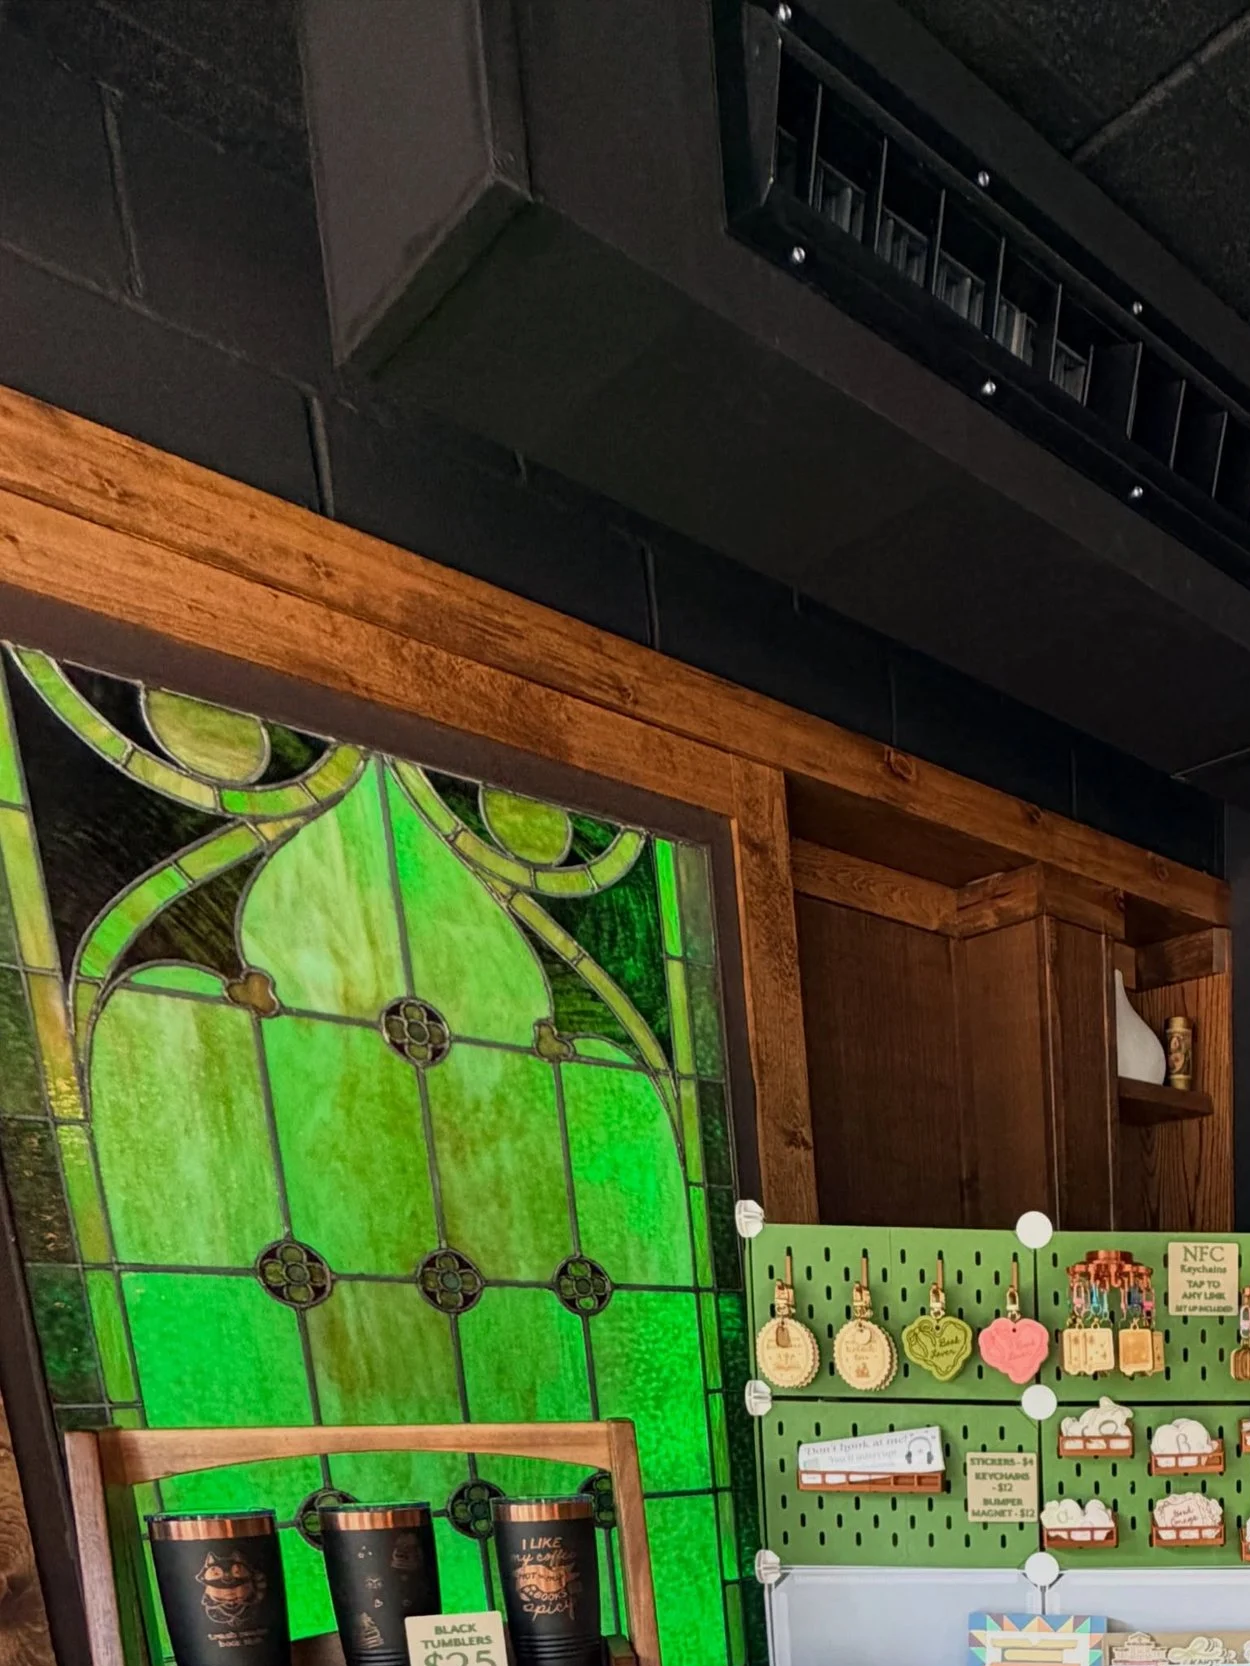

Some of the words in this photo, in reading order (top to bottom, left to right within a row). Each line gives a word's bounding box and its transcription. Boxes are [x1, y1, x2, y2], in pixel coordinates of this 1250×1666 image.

[1183, 1246, 1225, 1262] NFC
[1180, 1264, 1227, 1275] Keychains
[1187, 1280, 1205, 1288] TAP
[1207, 1280, 1221, 1288] TO
[1182, 1292, 1202, 1300] ANY
[1204, 1292, 1226, 1300] LINK
[938, 1337, 961, 1347] Book
[930, 1349, 957, 1360] Lover
[970, 1458, 1015, 1466] STICKERS
[1022, 1457, 1034, 1467] $4
[975, 1472, 1030, 1481] KEYCHAINS
[997, 1483, 1013, 1493] $12
[983, 1498, 1023, 1506] BUMPER
[971, 1509, 1012, 1518] MAGNET
[1019, 1509, 1035, 1518] $12
[521, 1539, 527, 1550] I
[530, 1536, 563, 1549] LIKE
[511, 1552, 534, 1566] my
[522, 1600, 575, 1621] spicy
[434, 1623, 477, 1635] BLACK
[421, 1636, 493, 1649] TUMBLERS
